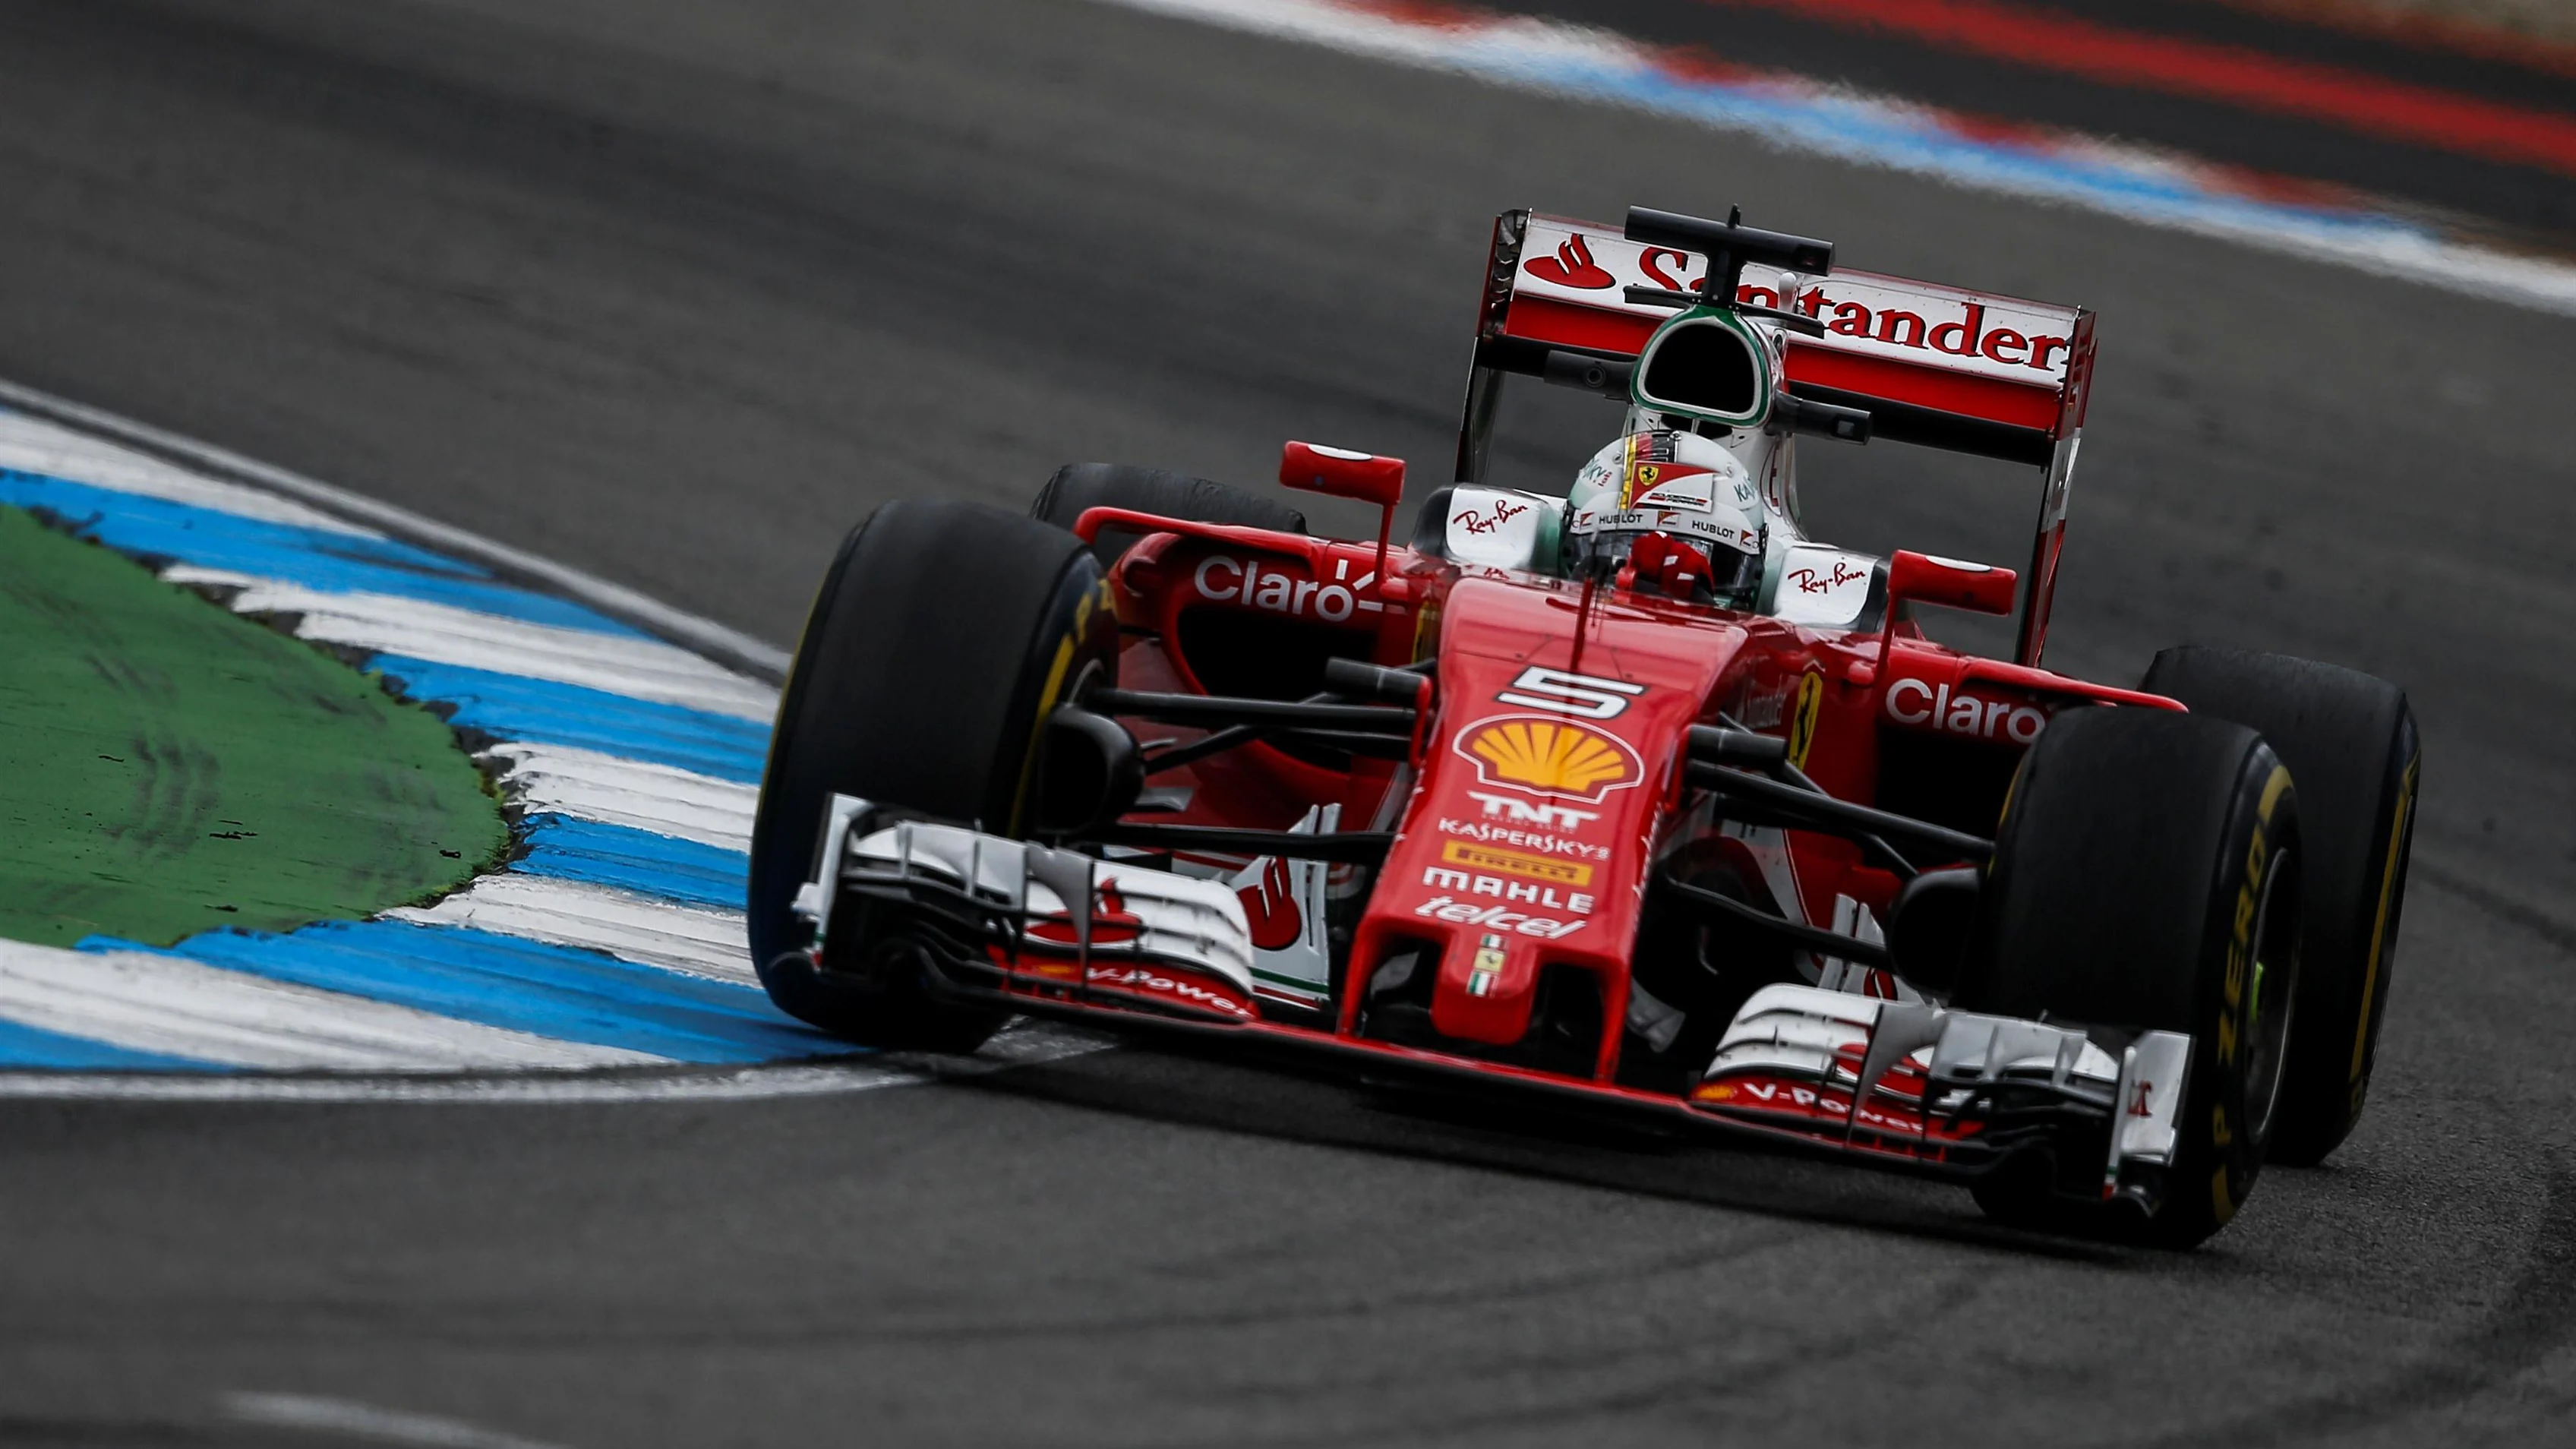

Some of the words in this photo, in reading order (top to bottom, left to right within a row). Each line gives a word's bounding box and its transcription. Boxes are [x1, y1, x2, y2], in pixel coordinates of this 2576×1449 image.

[1453, 499, 1528, 535] Ray-Ban
[1599, 513, 1643, 525] HUBLOT
[1692, 519, 1735, 539] HUBLOT
[1195, 554, 1353, 622] Claro
[1788, 562, 1866, 594] Ray-Ban
[1495, 665, 1649, 718] 5
[1886, 678, 2045, 743] Claro
[1466, 790, 1602, 829] TNT
[1422, 866, 1595, 914] MAHLE
[1415, 895, 1587, 939] telcel
[2216, 822, 2266, 1068] ZERO
[1087, 968, 1255, 1018] V-Power
